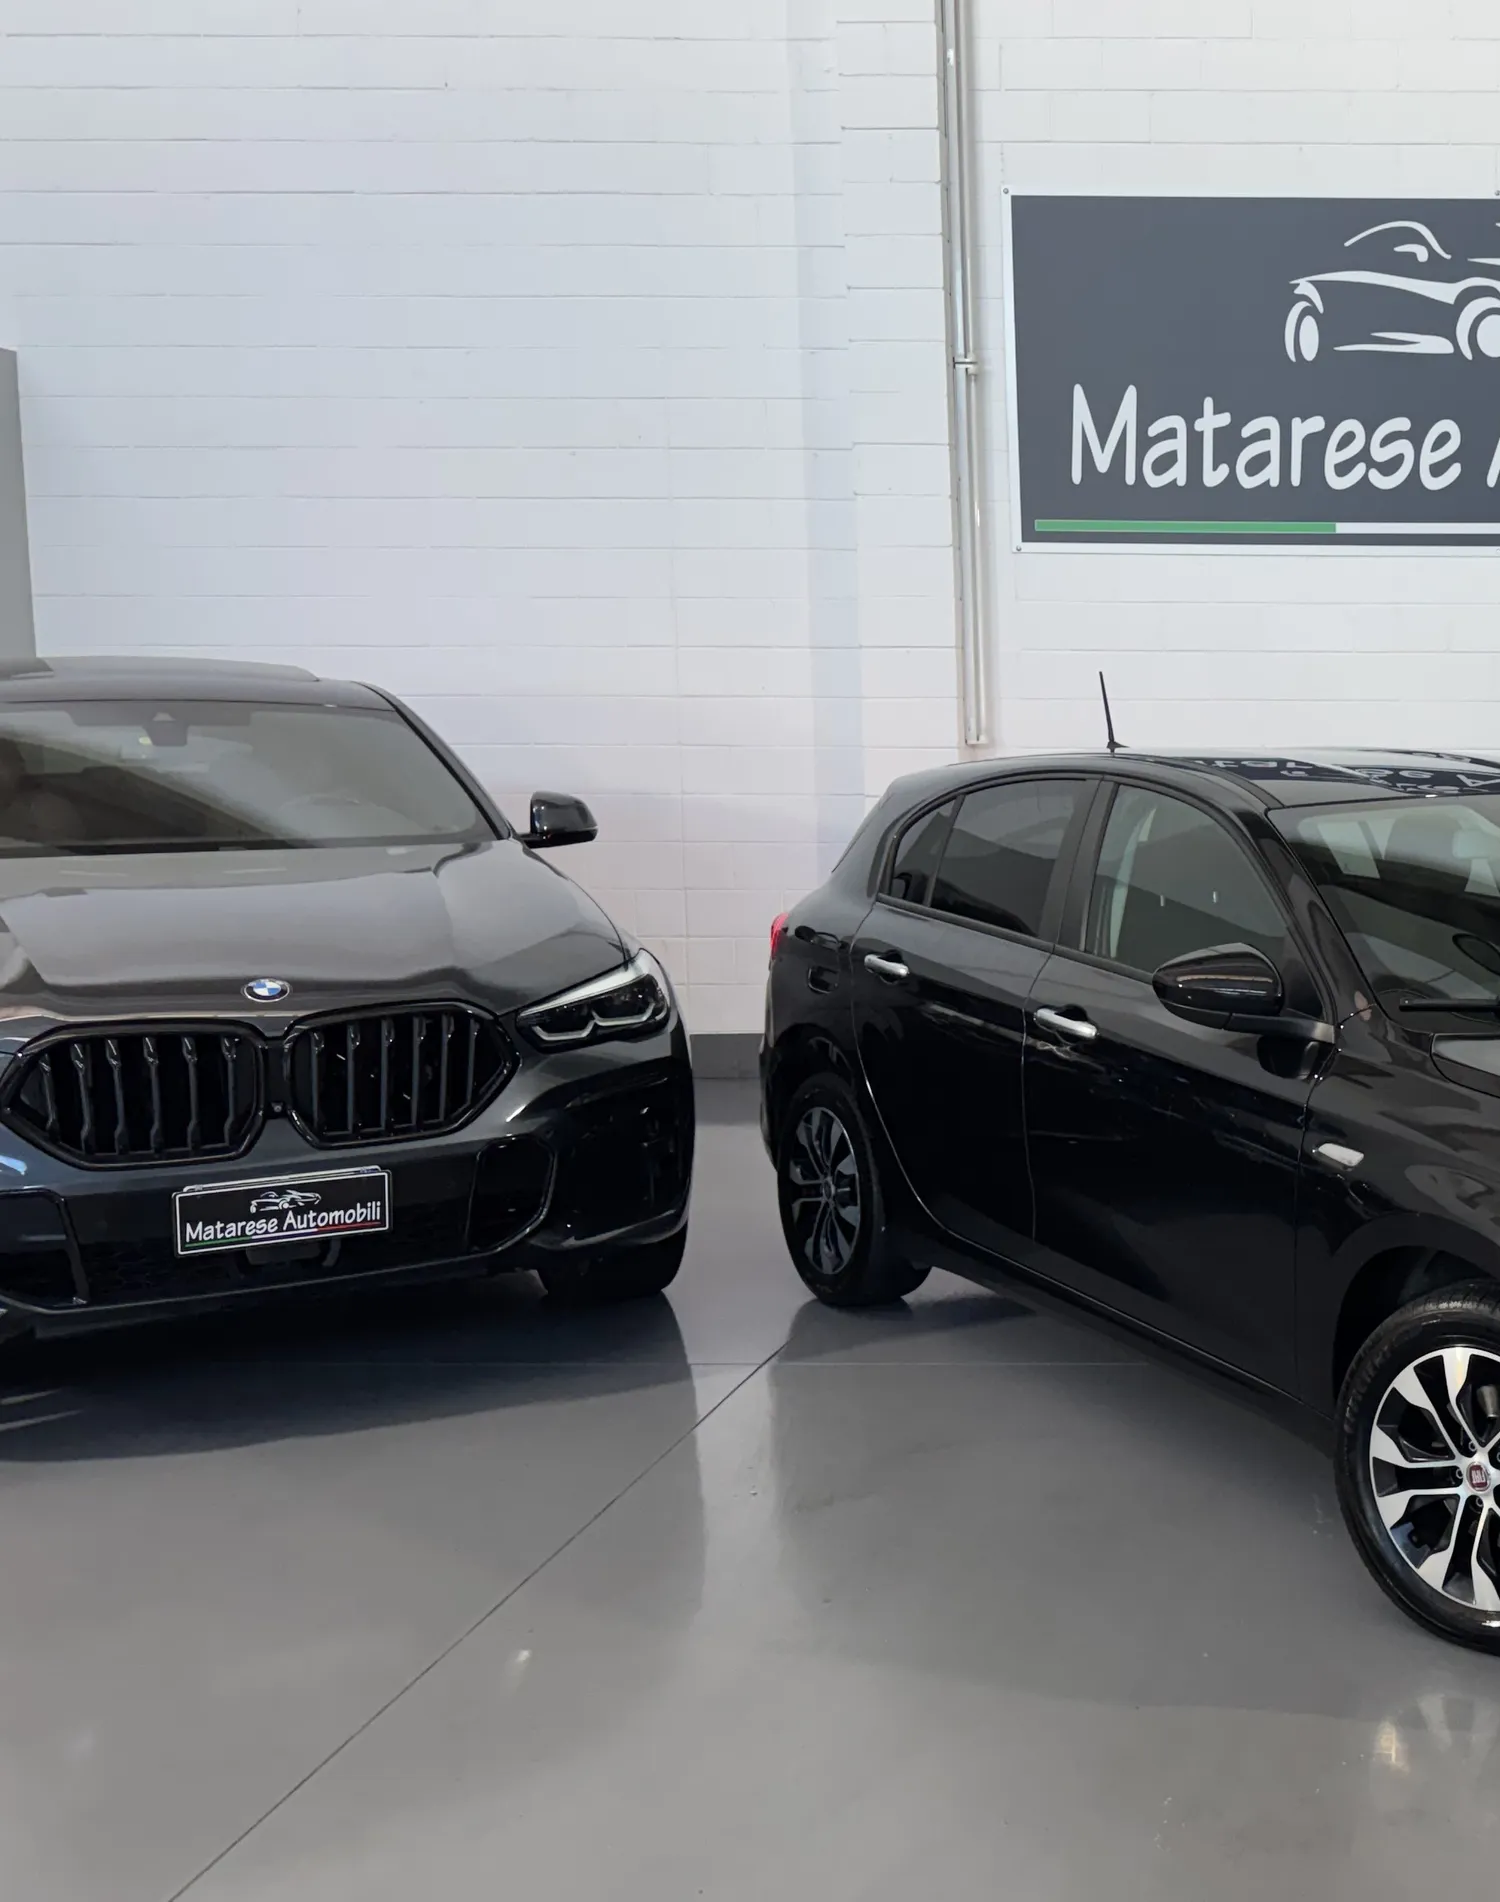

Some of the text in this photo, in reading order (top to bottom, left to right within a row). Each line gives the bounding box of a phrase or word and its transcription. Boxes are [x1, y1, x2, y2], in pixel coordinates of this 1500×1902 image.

[1071, 384, 1462, 490] Matarese
[186, 1201, 381, 1243] Matarese Automobili
